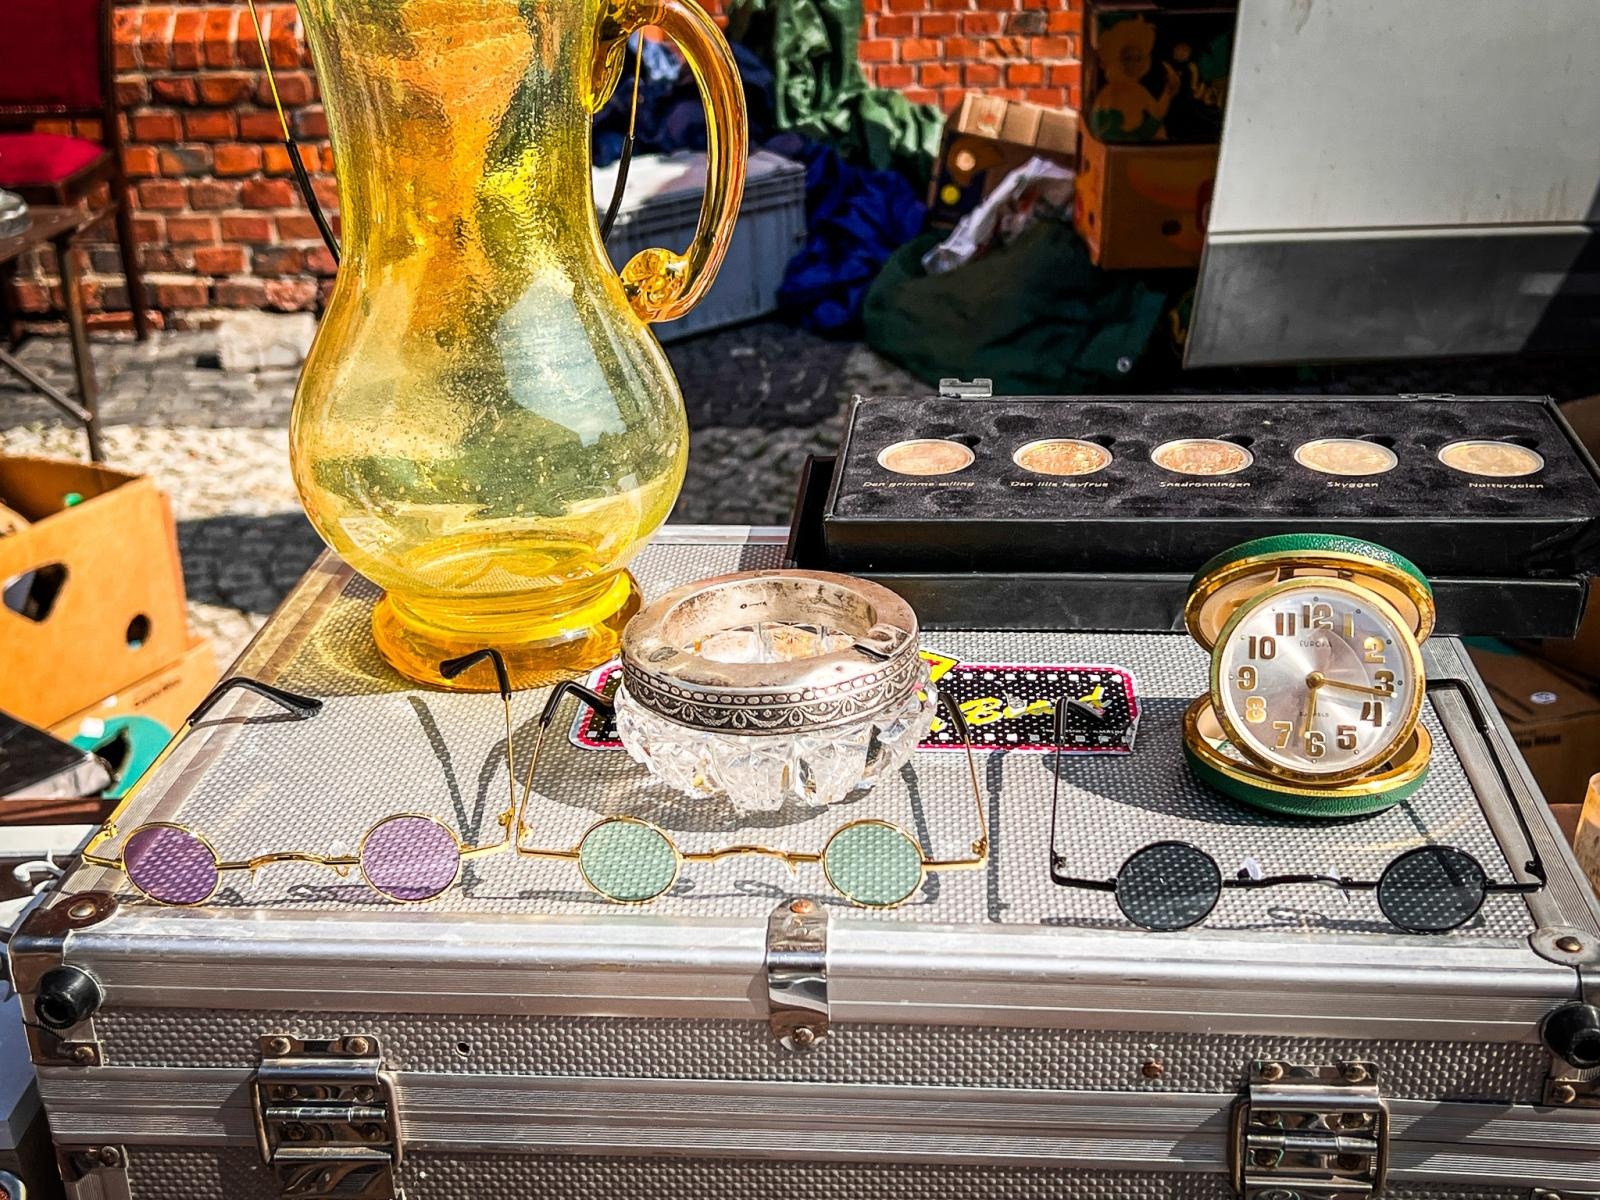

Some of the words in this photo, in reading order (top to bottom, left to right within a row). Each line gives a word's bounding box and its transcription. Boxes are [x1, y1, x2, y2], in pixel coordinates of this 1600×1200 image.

[1275, 612, 1296, 637] 11
[1303, 603, 1334, 630] 12
[1343, 613, 1355, 638] 1
[1248, 636, 1276, 660] 10
[1363, 636, 1386, 664] 2
[1237, 665, 1258, 691] 9
[1374, 670, 1395, 695] 3
[1246, 696, 1267, 723] 8
[1360, 701, 1383, 727] 4
[1273, 721, 1293, 749] 7
[1305, 731, 1326, 758] 6
[1337, 725, 1357, 750] 5
